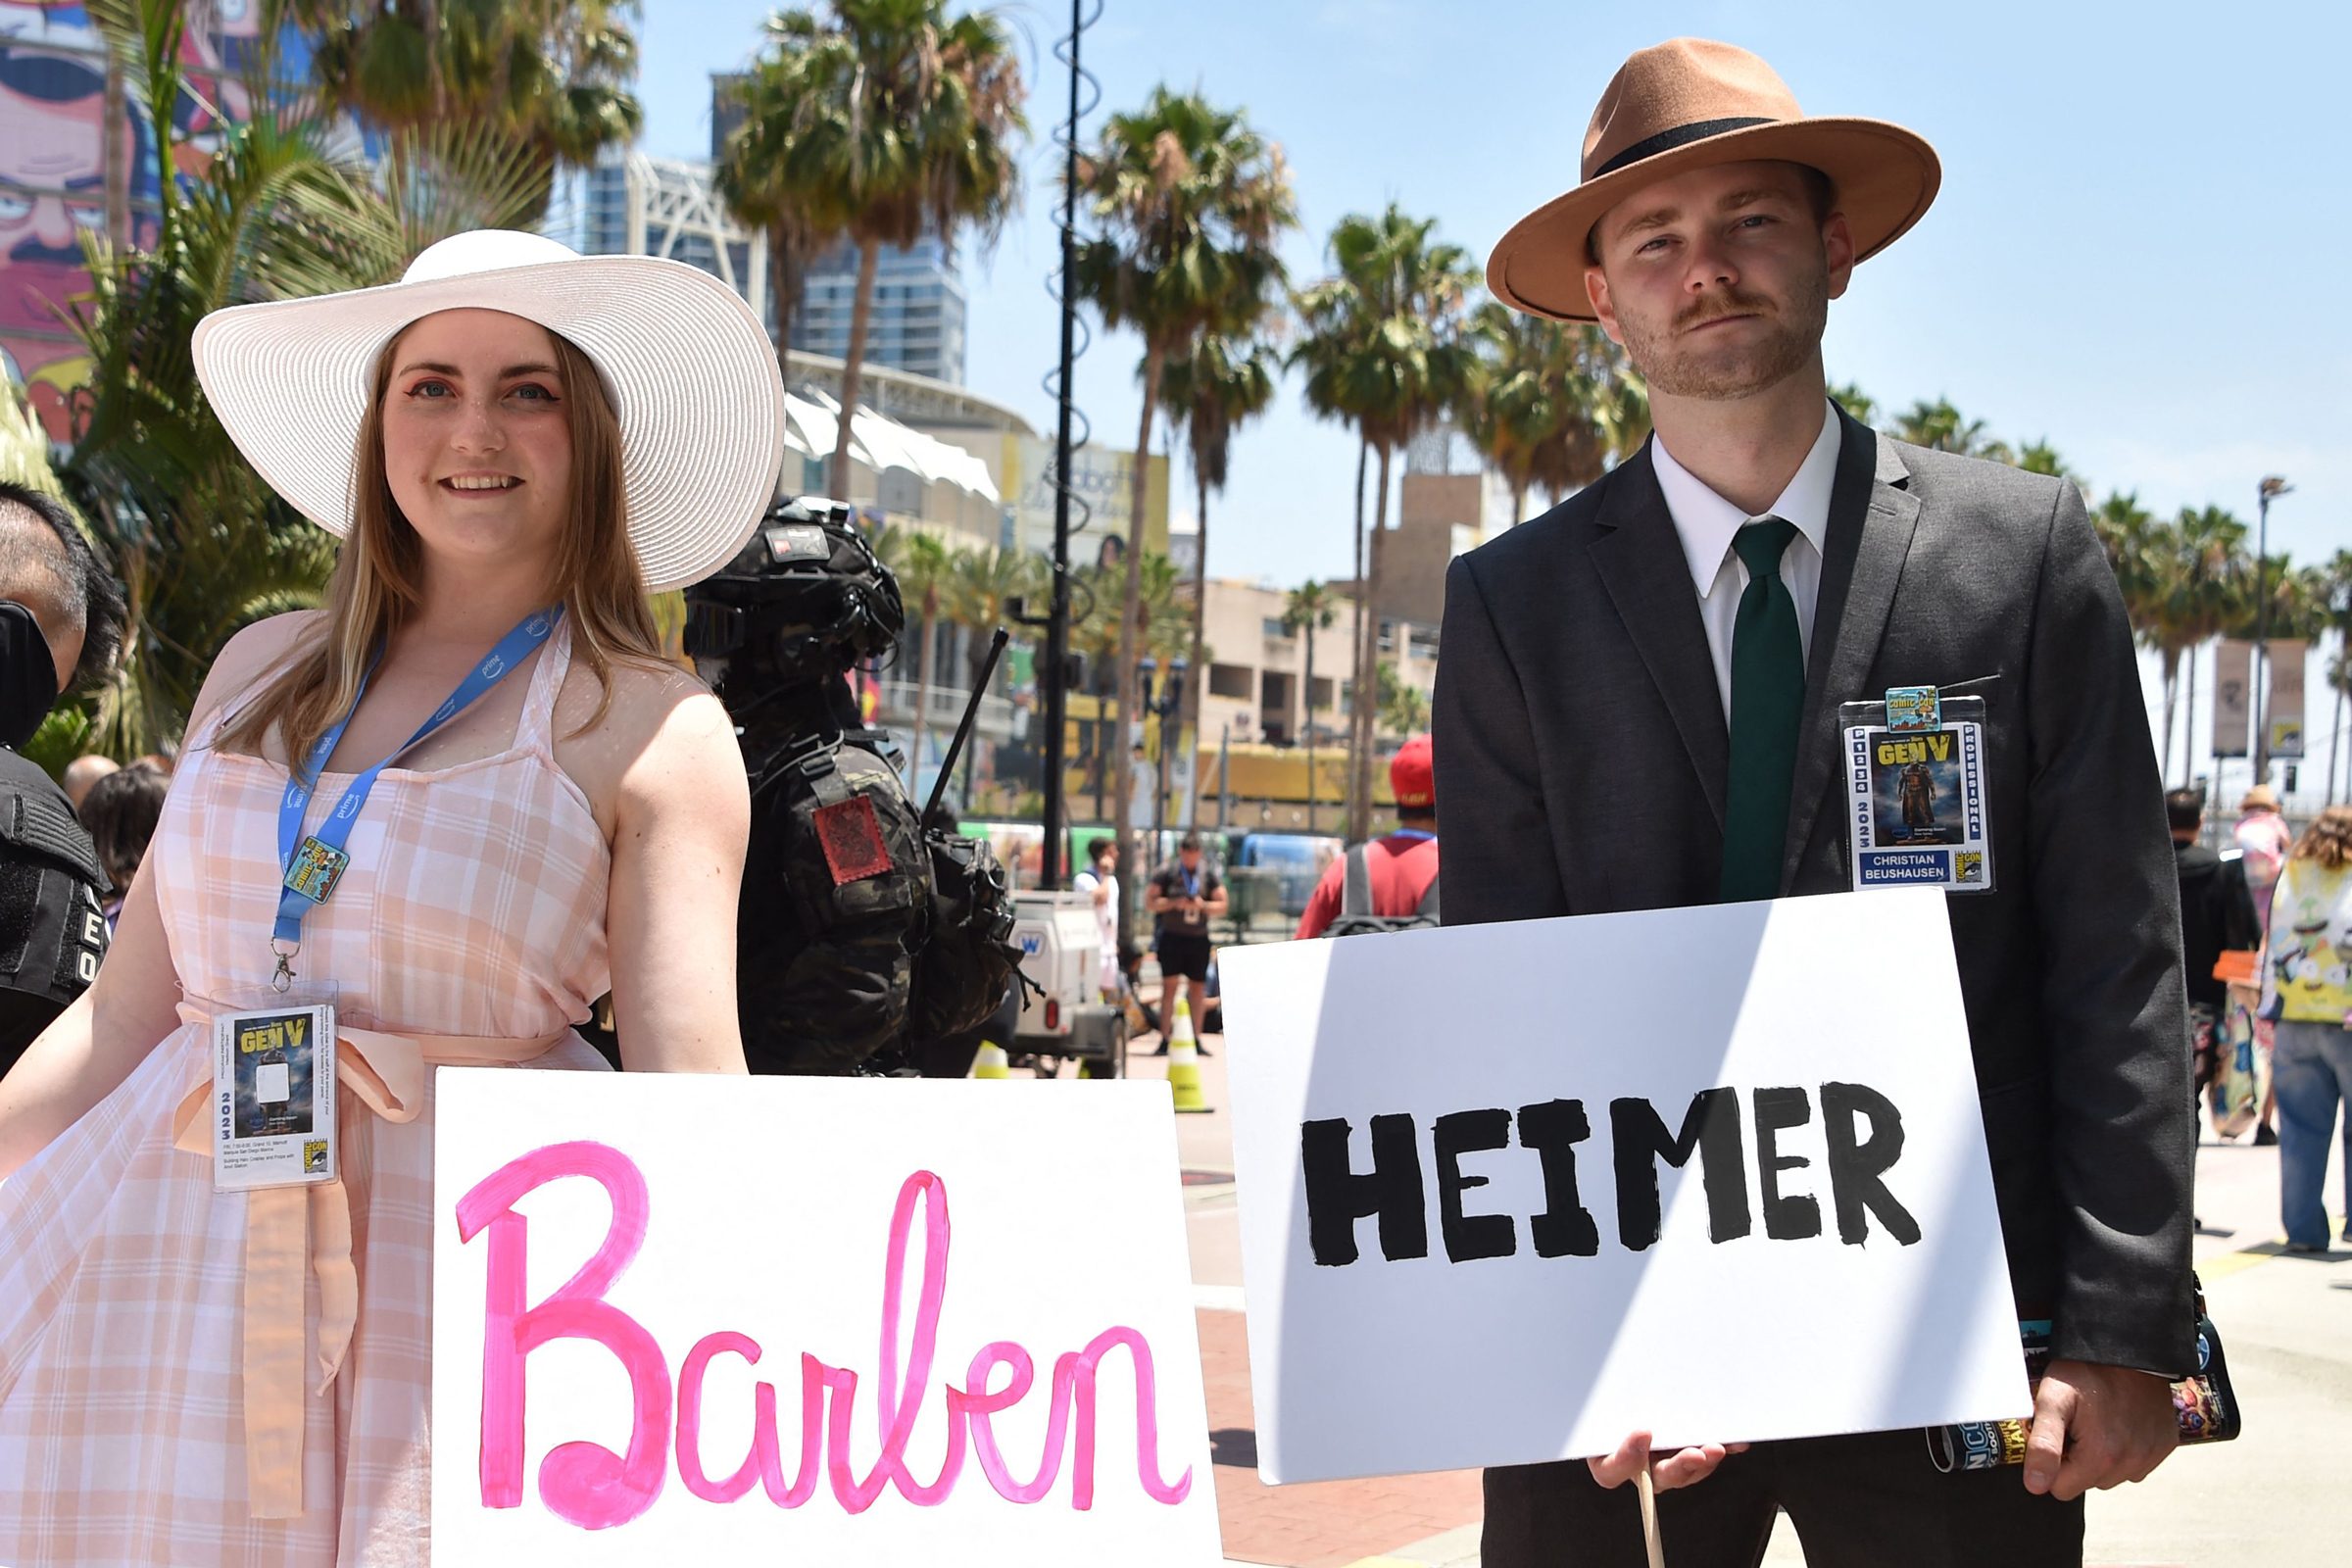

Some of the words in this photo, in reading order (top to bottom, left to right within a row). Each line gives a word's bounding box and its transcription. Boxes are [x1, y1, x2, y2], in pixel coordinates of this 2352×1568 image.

[481, 655, 501, 678] prime
[1878, 742, 1927, 764] GEN
[1927, 734, 1950, 761] V
[1964, 725, 1980, 833] PROFESSIONAL
[337, 793, 354, 819] prime
[1858, 802, 1870, 848] 2023
[1865, 867, 1944, 880] BEUSHAUSEN
[1873, 855, 1935, 866] CHRISTIAN
[1956, 854, 1965, 879] COMIC
[1964, 853, 1982, 862] CON
[1021, 936, 1040, 954] W
[241, 1027, 283, 1054] GEN
[284, 1018, 307, 1047] V
[221, 1093, 230, 1140] 2023
[312, 1142, 327, 1152] CON
[1300, 1082, 1922, 1267] HEIMER
[456, 1140, 1193, 1531] Barben
